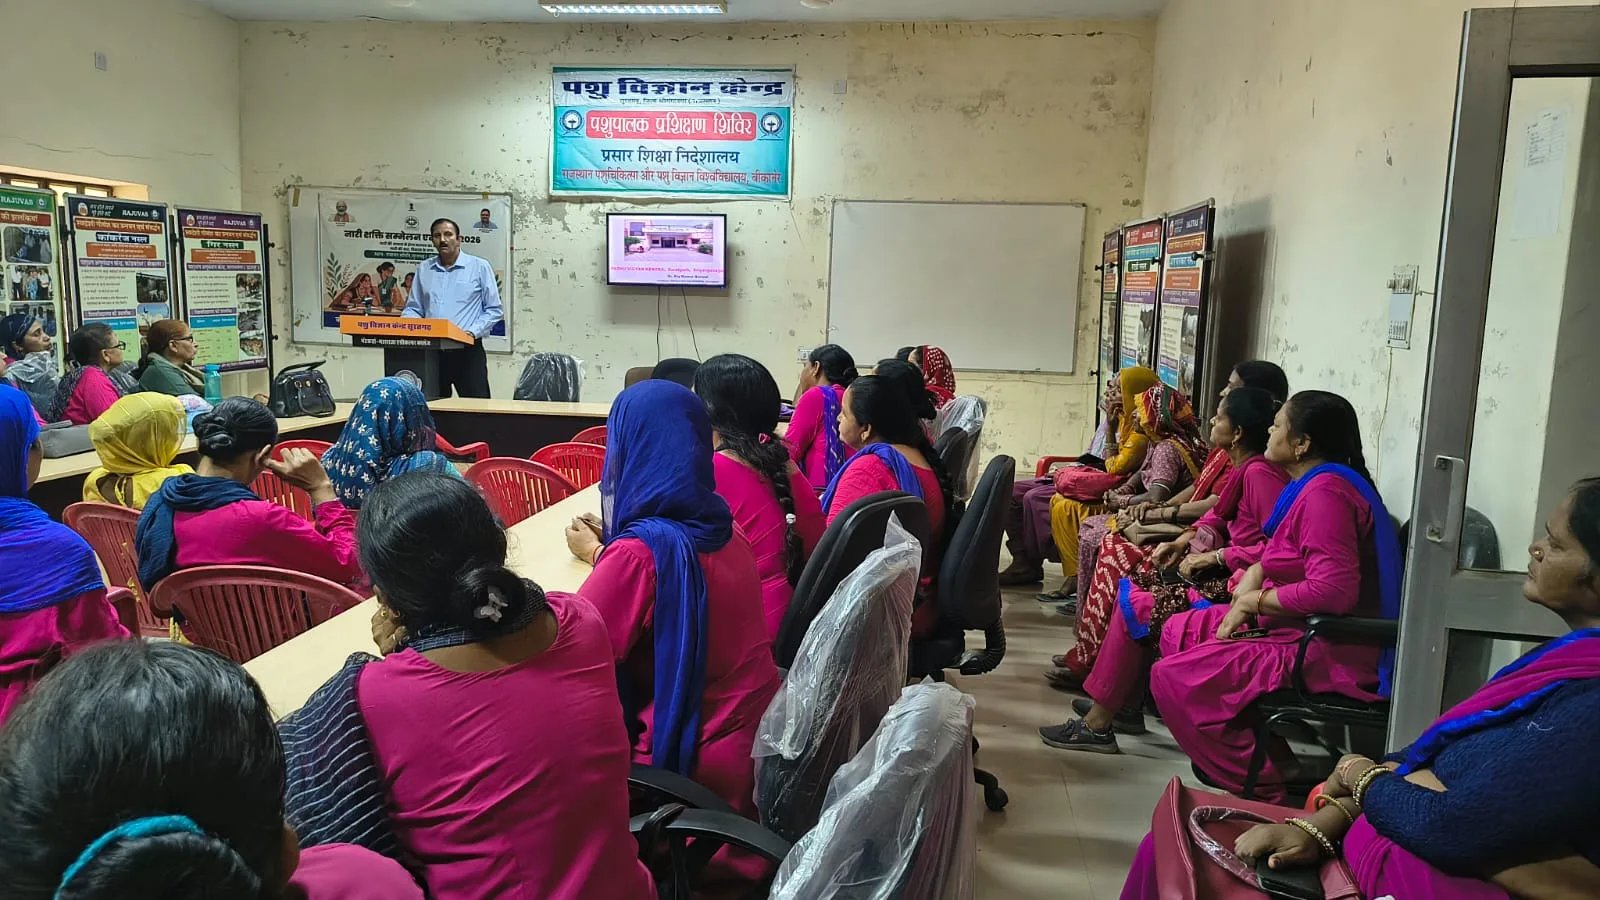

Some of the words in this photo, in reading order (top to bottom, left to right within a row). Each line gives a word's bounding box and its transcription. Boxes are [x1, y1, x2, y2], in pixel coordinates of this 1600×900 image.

[562, 81, 613, 99] पशु
[617, 78, 714, 95] विज्ञान
[719, 78, 786, 96] केन्द्र
[590, 116, 650, 138] पशुपालक
[655, 112, 707, 135] प्रशिक्षण
[713, 112, 753, 135] शिविर
[600, 149, 634, 162] प्रसार
[637, 145, 673, 165] शिक्षा
[675, 146, 741, 165] निदेशालय
[562, 168, 594, 180] राजस्थान
[640, 166, 654, 181] और
[656, 170, 671, 185] पशु
[672, 168, 695, 183] विज्ञान
[751, 169, 782, 184] बीकानेर
[122, 209, 149, 217] RAJUVAS
[344, 229, 362, 239] नारी
[363, 229, 384, 239] शक्ति
[385, 230, 421, 241] सम्मेलन
